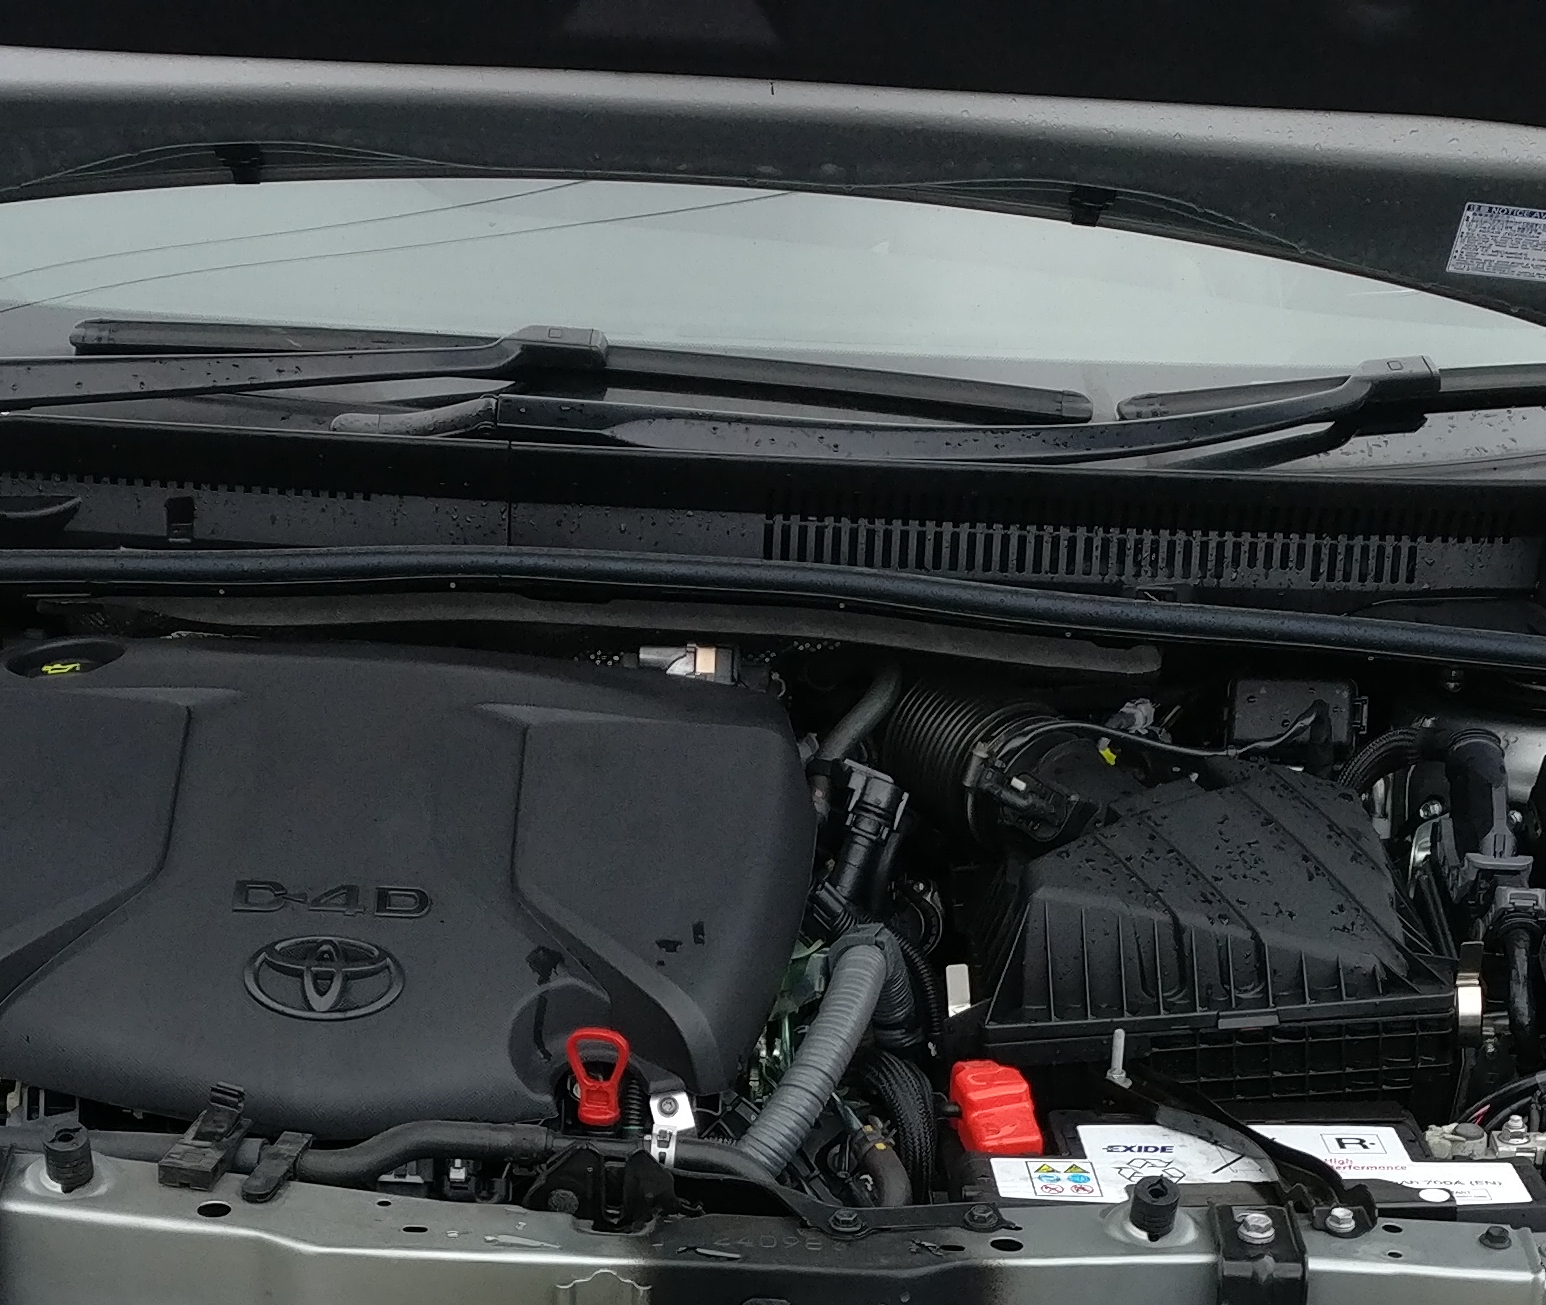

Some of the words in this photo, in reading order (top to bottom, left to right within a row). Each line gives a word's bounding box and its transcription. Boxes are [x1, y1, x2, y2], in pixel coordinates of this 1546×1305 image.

[1492, 206, 1531, 217] NOTICE
[232, 880, 432, 918] D-4D
[1105, 1144, 1175, 1154] EXIDE
